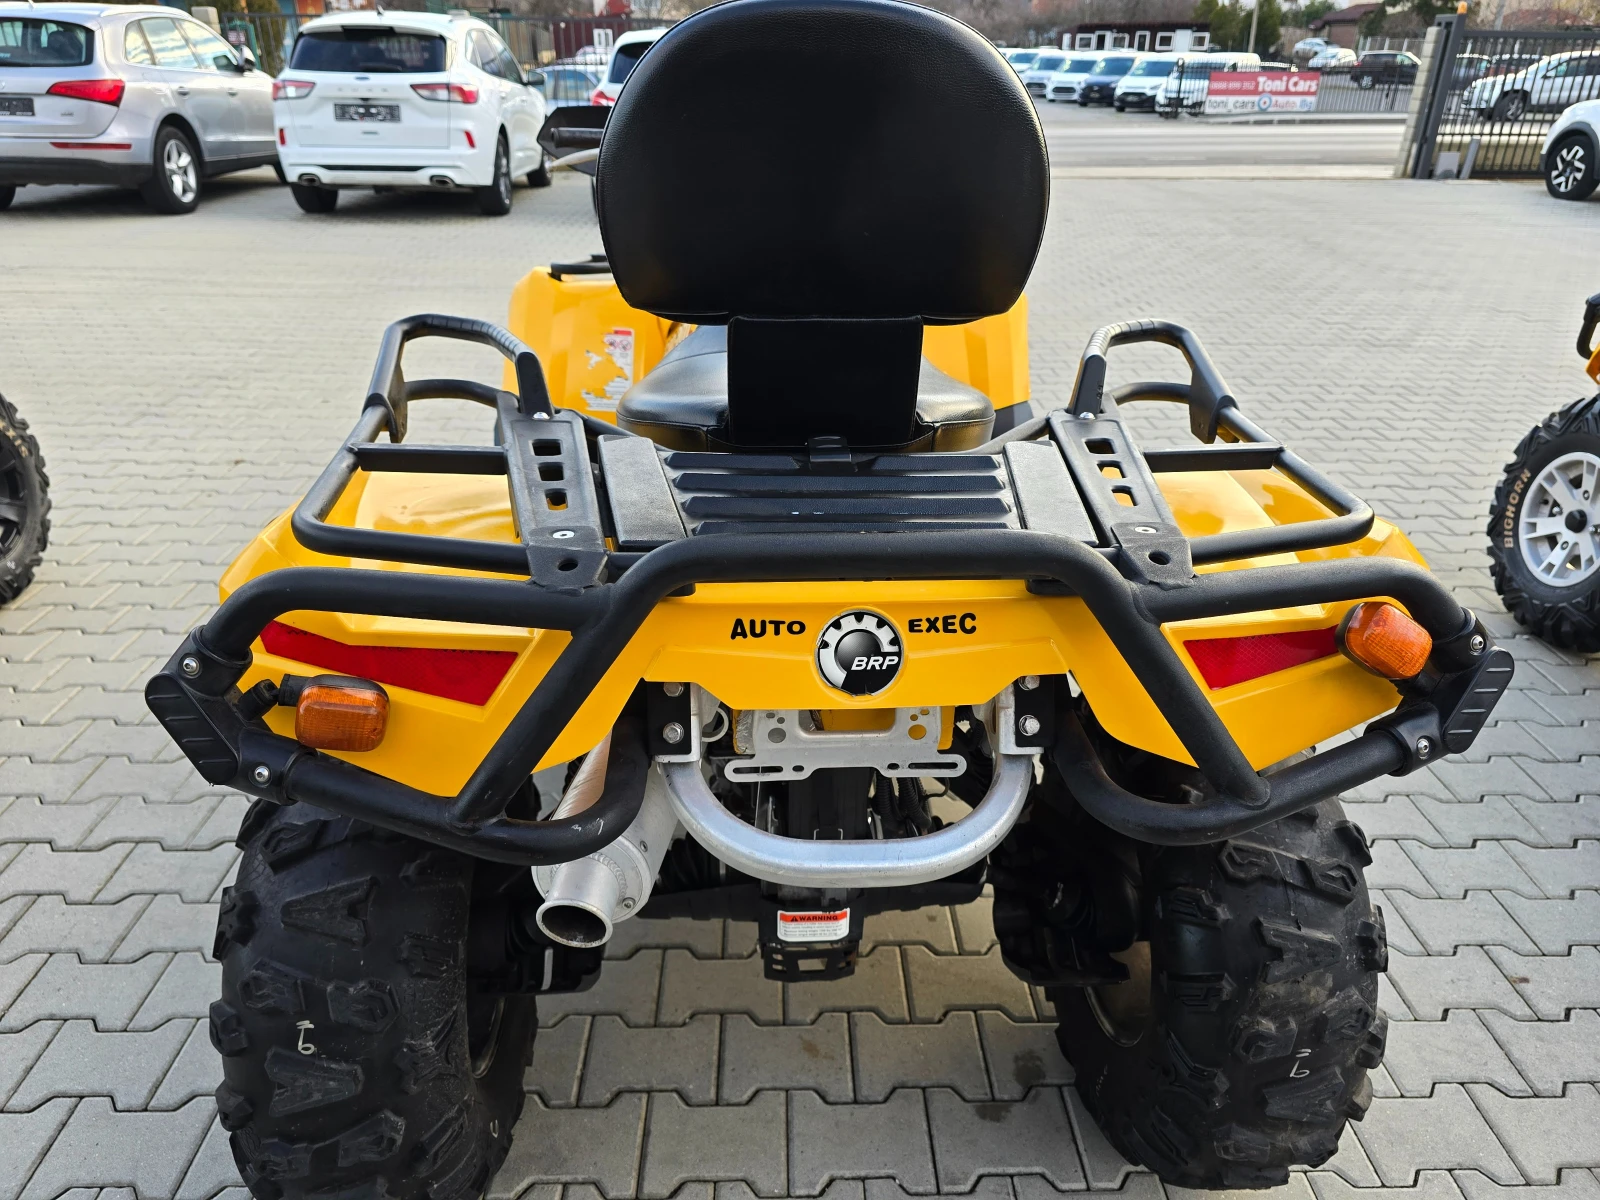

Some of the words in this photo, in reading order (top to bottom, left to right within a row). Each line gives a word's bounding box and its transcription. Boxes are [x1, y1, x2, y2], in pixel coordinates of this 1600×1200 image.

[1257, 75, 1287, 92] Toni
[1288, 75, 1318, 92] Cars
[1503, 468, 1531, 549] BIGHORN
[730, 618, 806, 640] AUTO
[908, 612, 977, 635] EXEC
[851, 655, 899, 671] BRP
